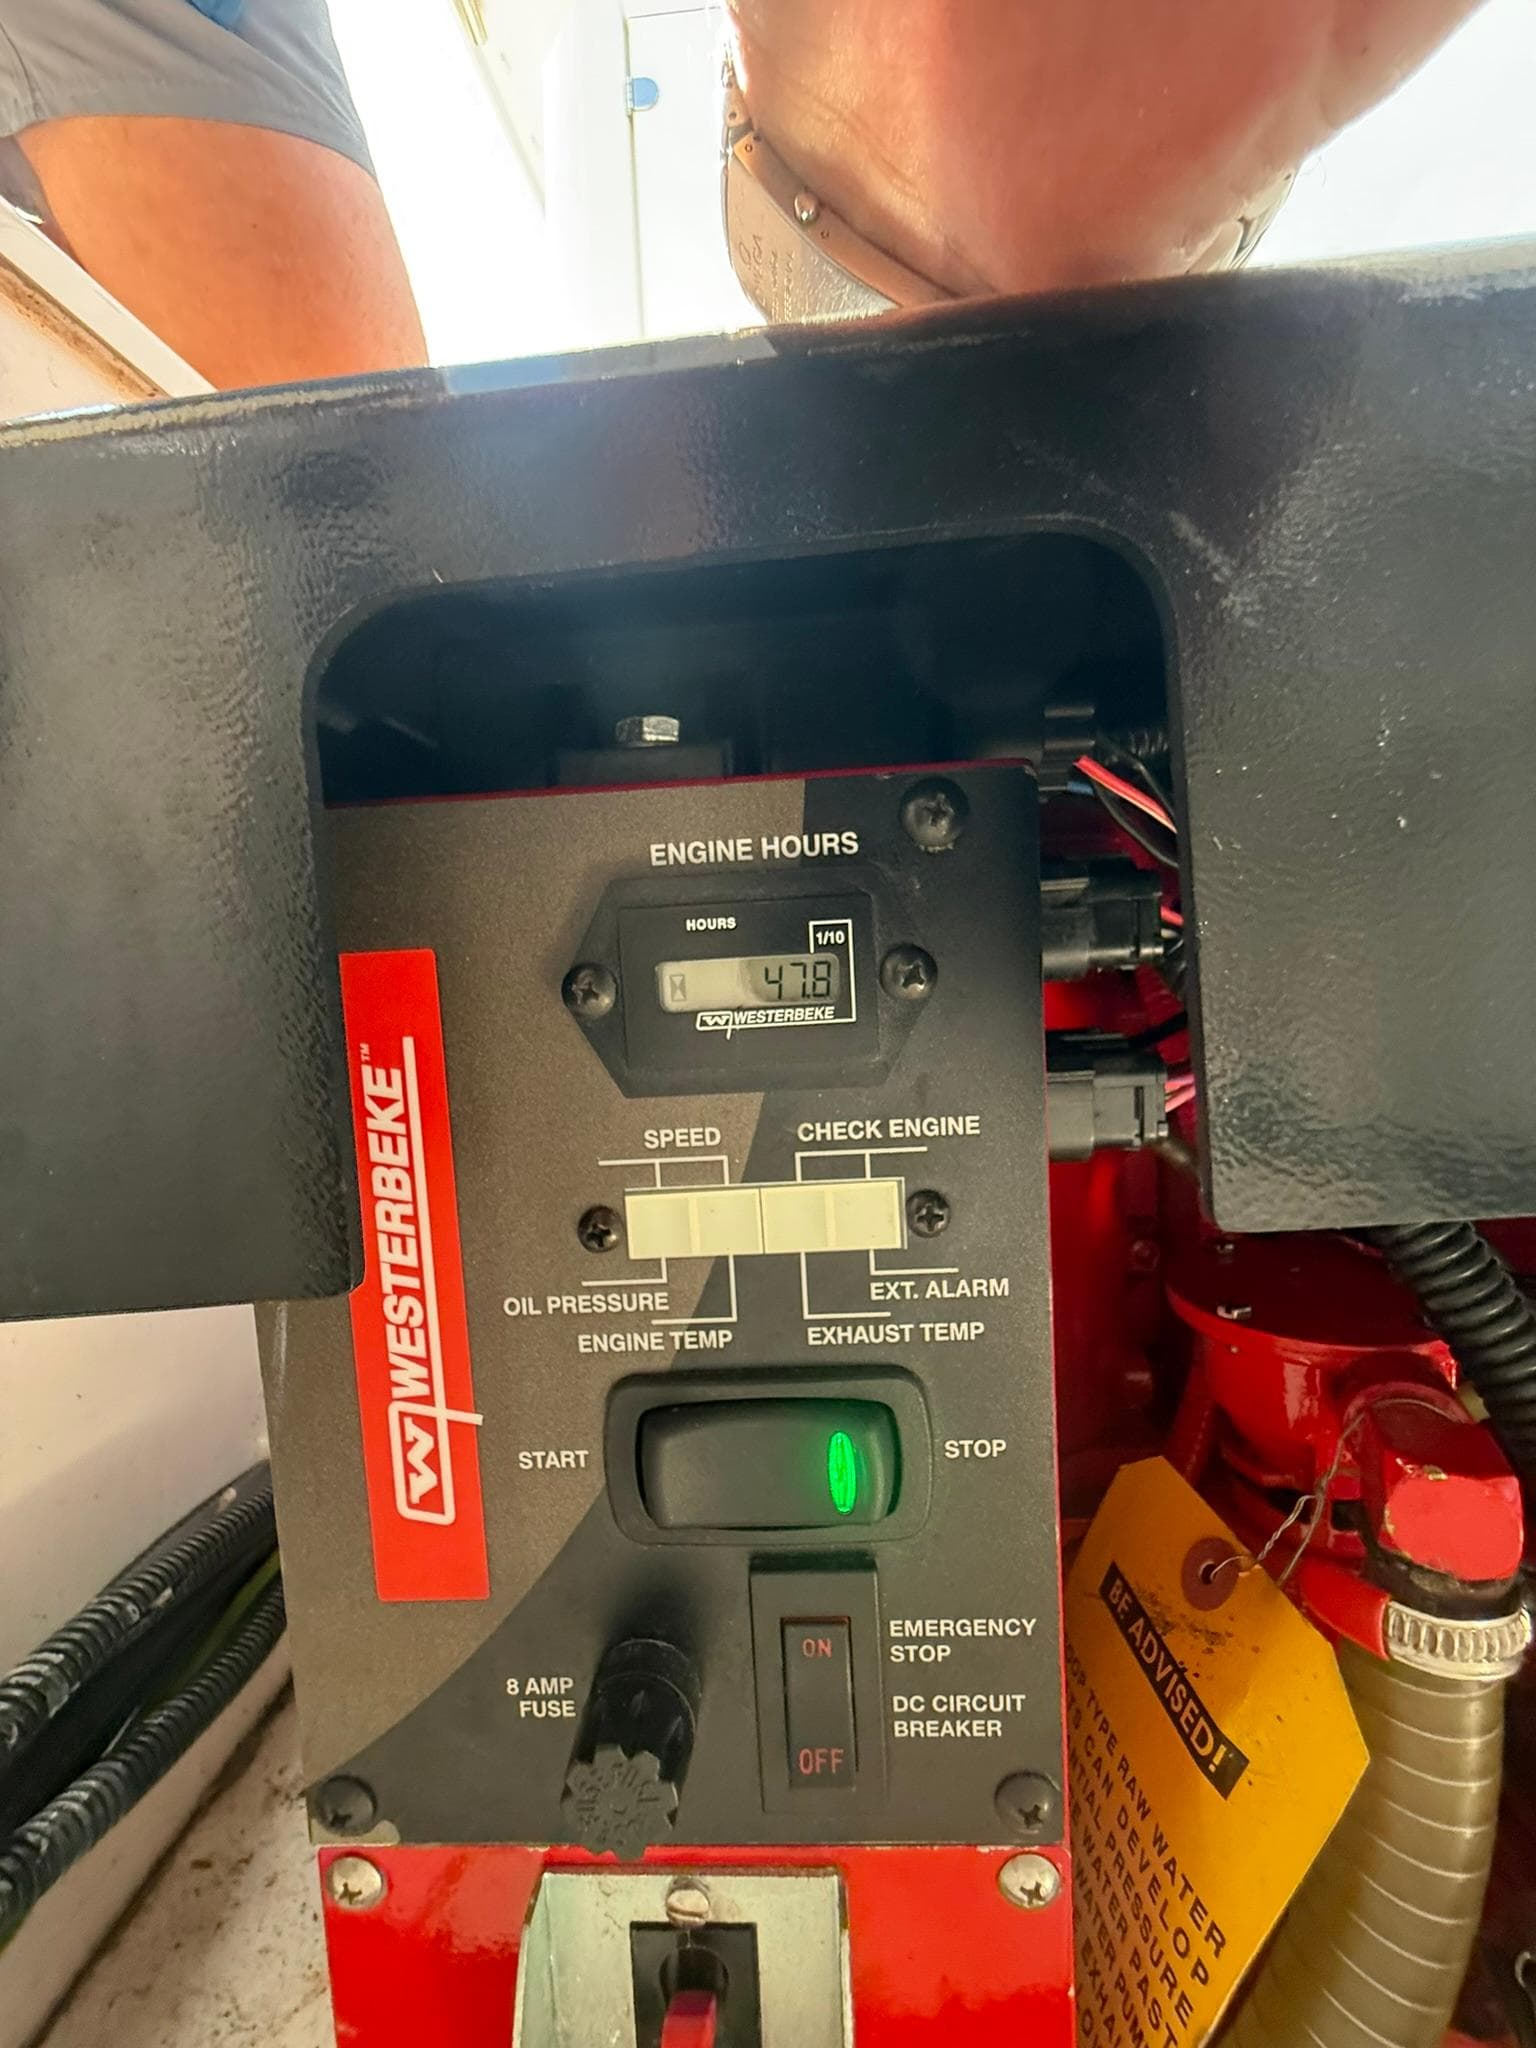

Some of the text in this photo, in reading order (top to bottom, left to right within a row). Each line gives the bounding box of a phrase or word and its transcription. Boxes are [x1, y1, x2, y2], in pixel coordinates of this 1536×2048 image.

[649, 831, 859, 866] ENGINE HOURS
[686, 916, 737, 931] HOURS
[815, 930, 845, 945] 1/10
[764, 960, 832, 1000] 47.8
[733, 1005, 836, 1026] WESTERBEKE
[644, 1126, 721, 1149] SPEED
[797, 1115, 981, 1142] CHECK ENGINE
[361, 1063, 431, 1400] WESTERBEKE
[870, 1278, 1010, 1301] EXT. ALARM
[503, 1291, 670, 1316] OIL PRESSURE
[578, 1328, 733, 1353] ENGINE TEMP
[807, 1321, 985, 1346] EXHAUST TEMP
[518, 1449, 589, 1470] START
[944, 1439, 1007, 1459] STOP
[889, 1618, 1037, 1637] EMERGENCY
[801, 1638, 833, 1659] ON
[890, 1644, 951, 1663] STOP
[506, 1677, 574, 1696] 8 AMP
[1127, 1617, 1228, 1774] ADVISED!
[519, 1700, 576, 1718] FUSE
[892, 1694, 1026, 1713] DC CIRCUIT
[894, 1719, 1002, 1738] BREAKER
[799, 1747, 844, 1775] OFF
[1087, 1687, 1118, 1757] TYPE
[1117, 1753, 1152, 1822] RAW
[1151, 1822, 1227, 1960] WATER
[1084, 1734, 1210, 1987] CAN DEVELOP
[1082, 1827, 1129, 1944] WATER
[1128, 1945, 1179, 2048] PAST
[1105, 1830, 1194, 2030] PRESSURE
[1076, 1857, 1117, 1972] WATER
[1114, 1970, 1151, 2048] PUM
